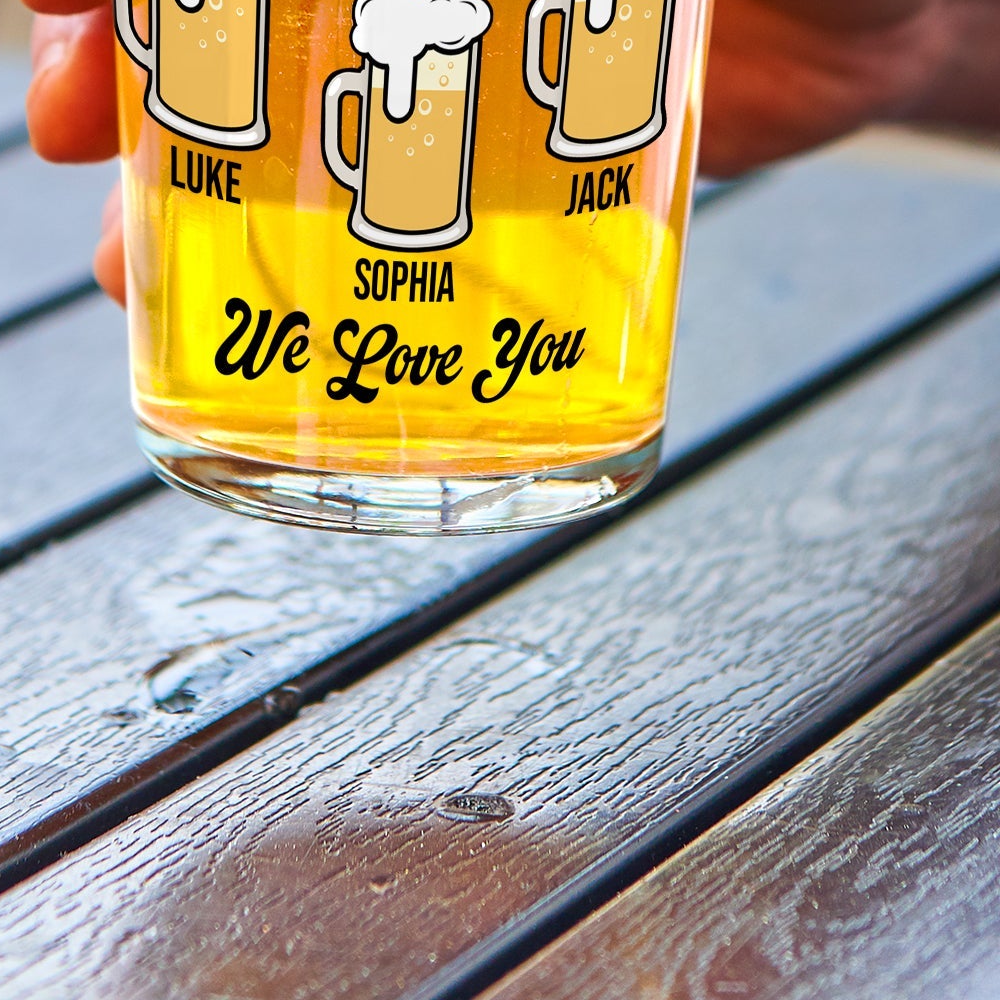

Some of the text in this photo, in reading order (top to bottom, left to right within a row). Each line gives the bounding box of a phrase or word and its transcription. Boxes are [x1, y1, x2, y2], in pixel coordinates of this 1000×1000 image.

[169, 145, 242, 205] LUKE
[564, 163, 635, 217] JACK
[353, 258, 456, 304] SOPHIA
[214, 297, 587, 404] We Love You
